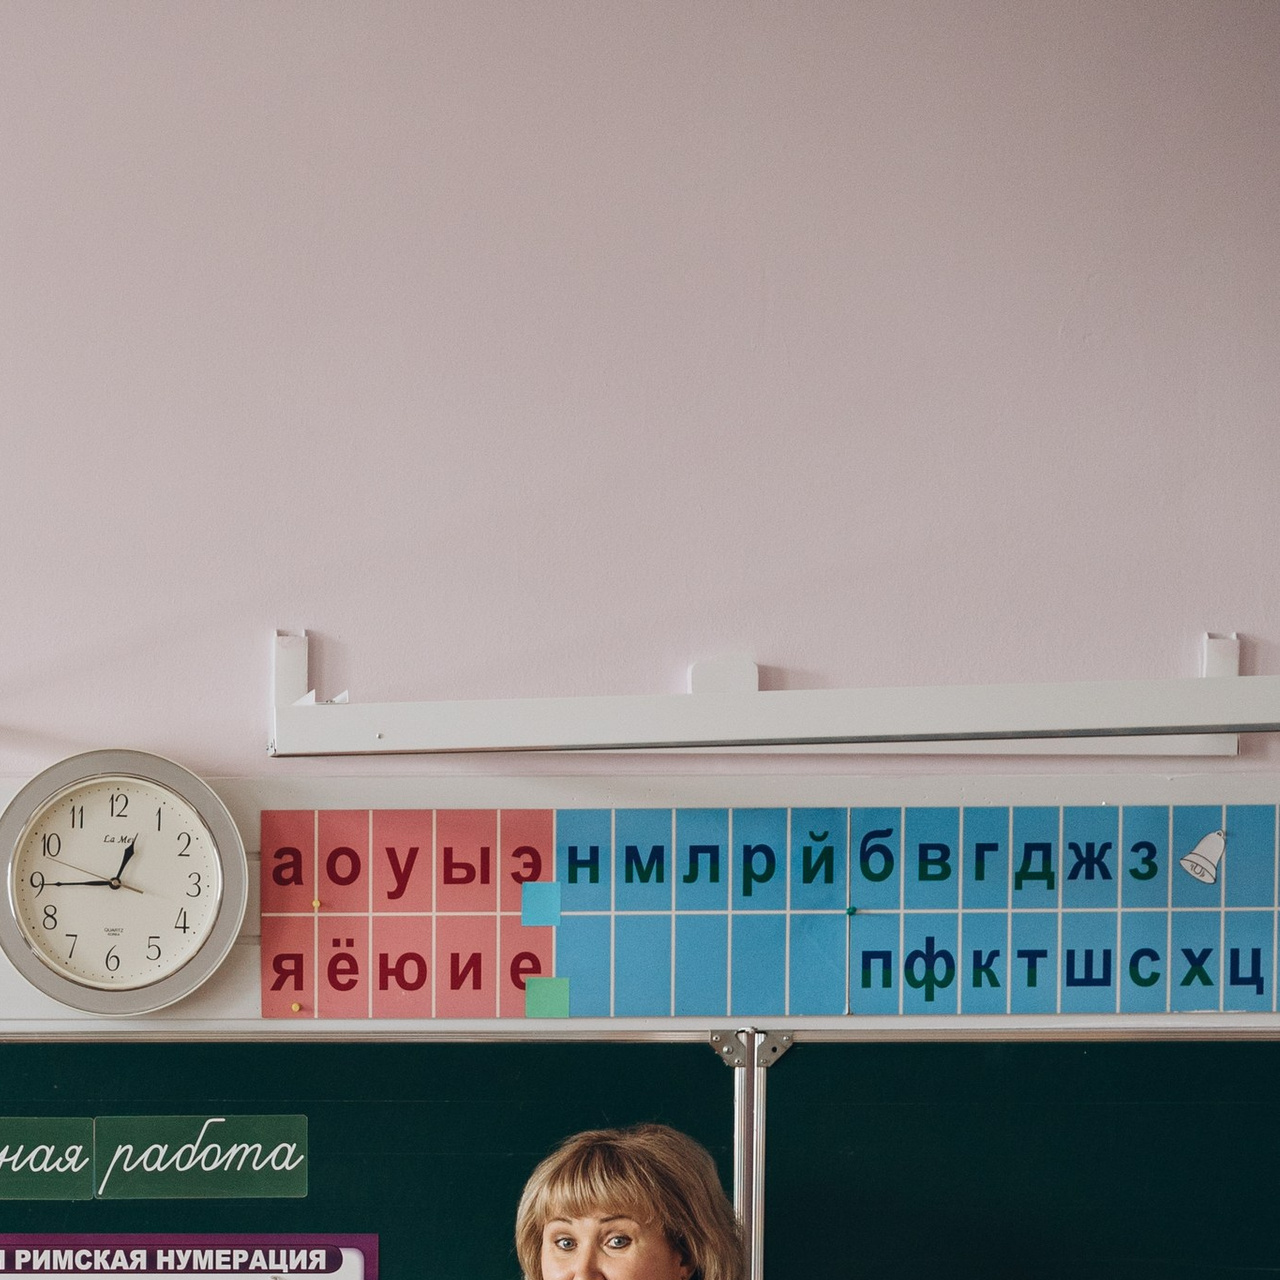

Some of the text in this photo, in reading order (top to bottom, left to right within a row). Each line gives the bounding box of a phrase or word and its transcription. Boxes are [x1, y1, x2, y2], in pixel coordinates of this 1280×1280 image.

[70, 805, 84, 829] 11
[109, 793, 129, 818] 12
[155, 807, 162, 831] 1
[41, 832, 62, 857] 10
[103, 834, 115, 844] La
[177, 831, 191, 857] 2
[272, 828, 1159, 900] а о у ы э н м л р й б в г д ж з
[30, 871, 45, 899] 9
[185, 872, 201, 898] 3
[42, 904, 58, 930] 8
[174, 907, 190, 934] 4
[65, 934, 78, 959] 7
[105, 945, 120, 971] 6
[146, 936, 162, 961] 5
[270, 936, 1264, 1002] я ё ю и е п ф к т ш с х ц
[98, 1117, 305, 1196] работа
[20, 1249, 147, 1271] РИМСКАЯ
[156, 1249, 327, 1274] НУМЕРАЦИЯ
